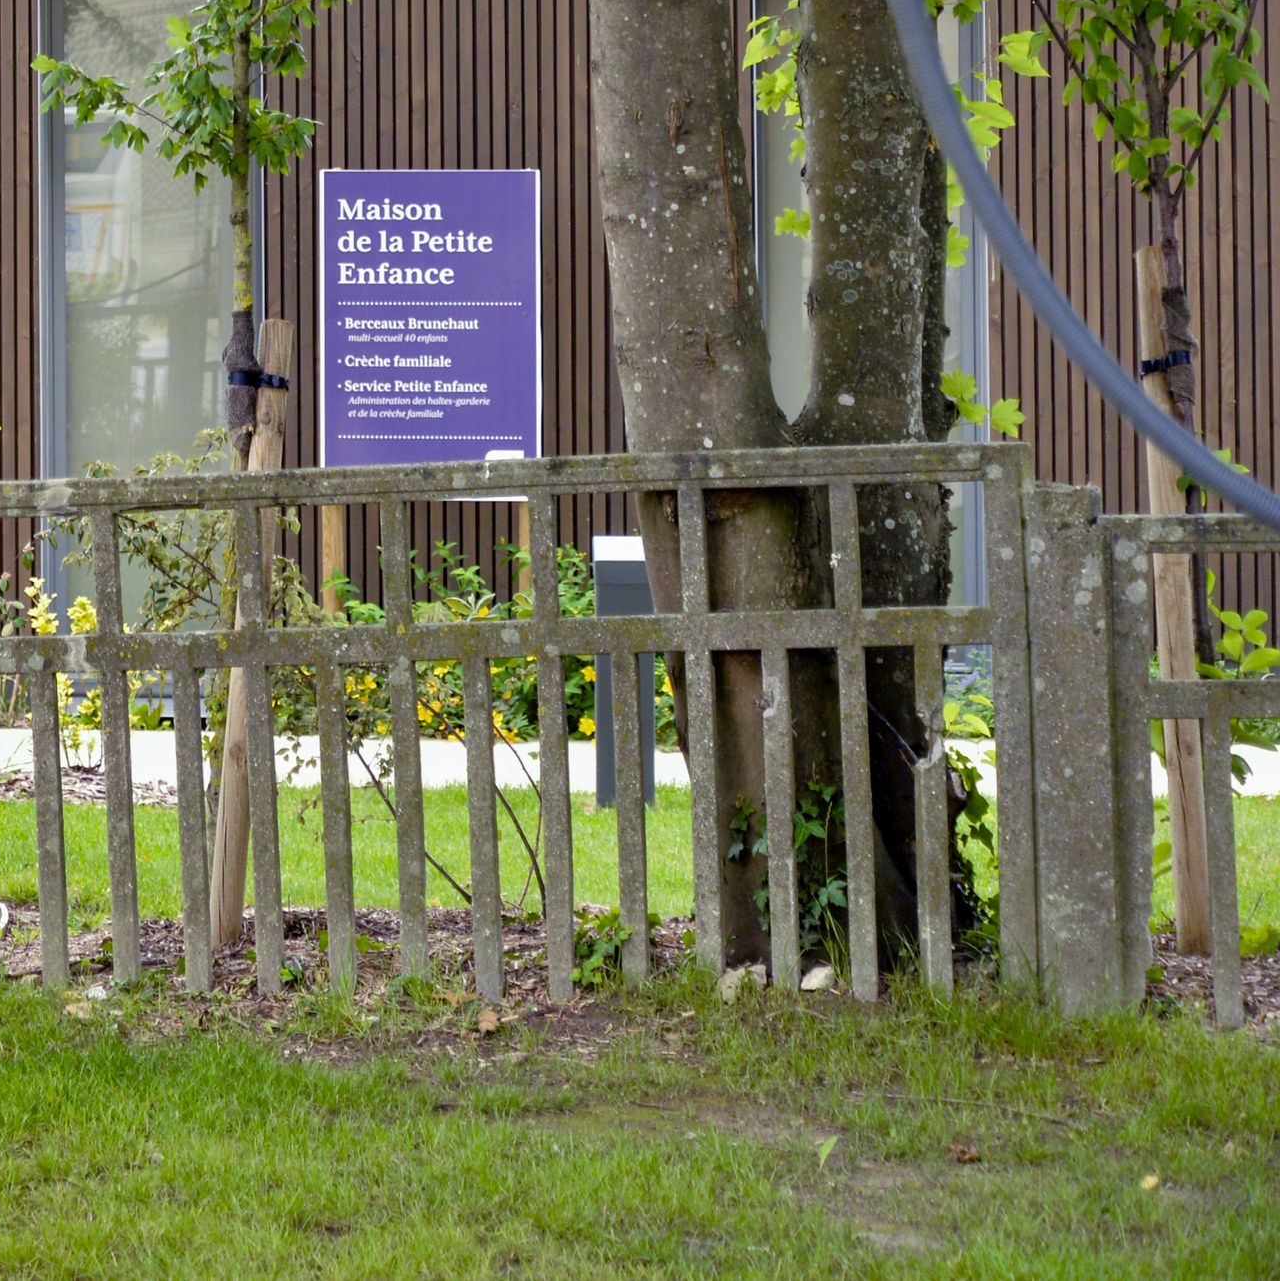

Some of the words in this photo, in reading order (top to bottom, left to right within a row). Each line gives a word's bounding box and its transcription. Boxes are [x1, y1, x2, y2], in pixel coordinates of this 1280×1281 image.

[337, 198, 443, 220] Maison
[337, 230, 372, 252] de
[379, 230, 404, 252] la
[411, 230, 493, 252] Petite
[337, 262, 455, 284] Enfance
[345, 318, 405, 330] Berceaux
[408, 318, 479, 330] Brunehaut
[348, 334, 403, 342] multi-accueil
[404, 334, 416, 342] 40
[417, 334, 448, 344] enfants
[345, 355, 391, 367] Crèche
[394, 355, 451, 367] familiale
[344, 380, 391, 392] Service
[394, 380, 431, 392] Petite
[434, 381, 487, 393] Enfance
[348, 396, 411, 405] Administration
[412, 397, 426, 405] des
[348, 409, 356, 417] et
[357, 409, 369, 417] de
[370, 409, 378, 417] la
[379, 409, 405, 418] crèche
[406, 409, 444, 420] familiale
